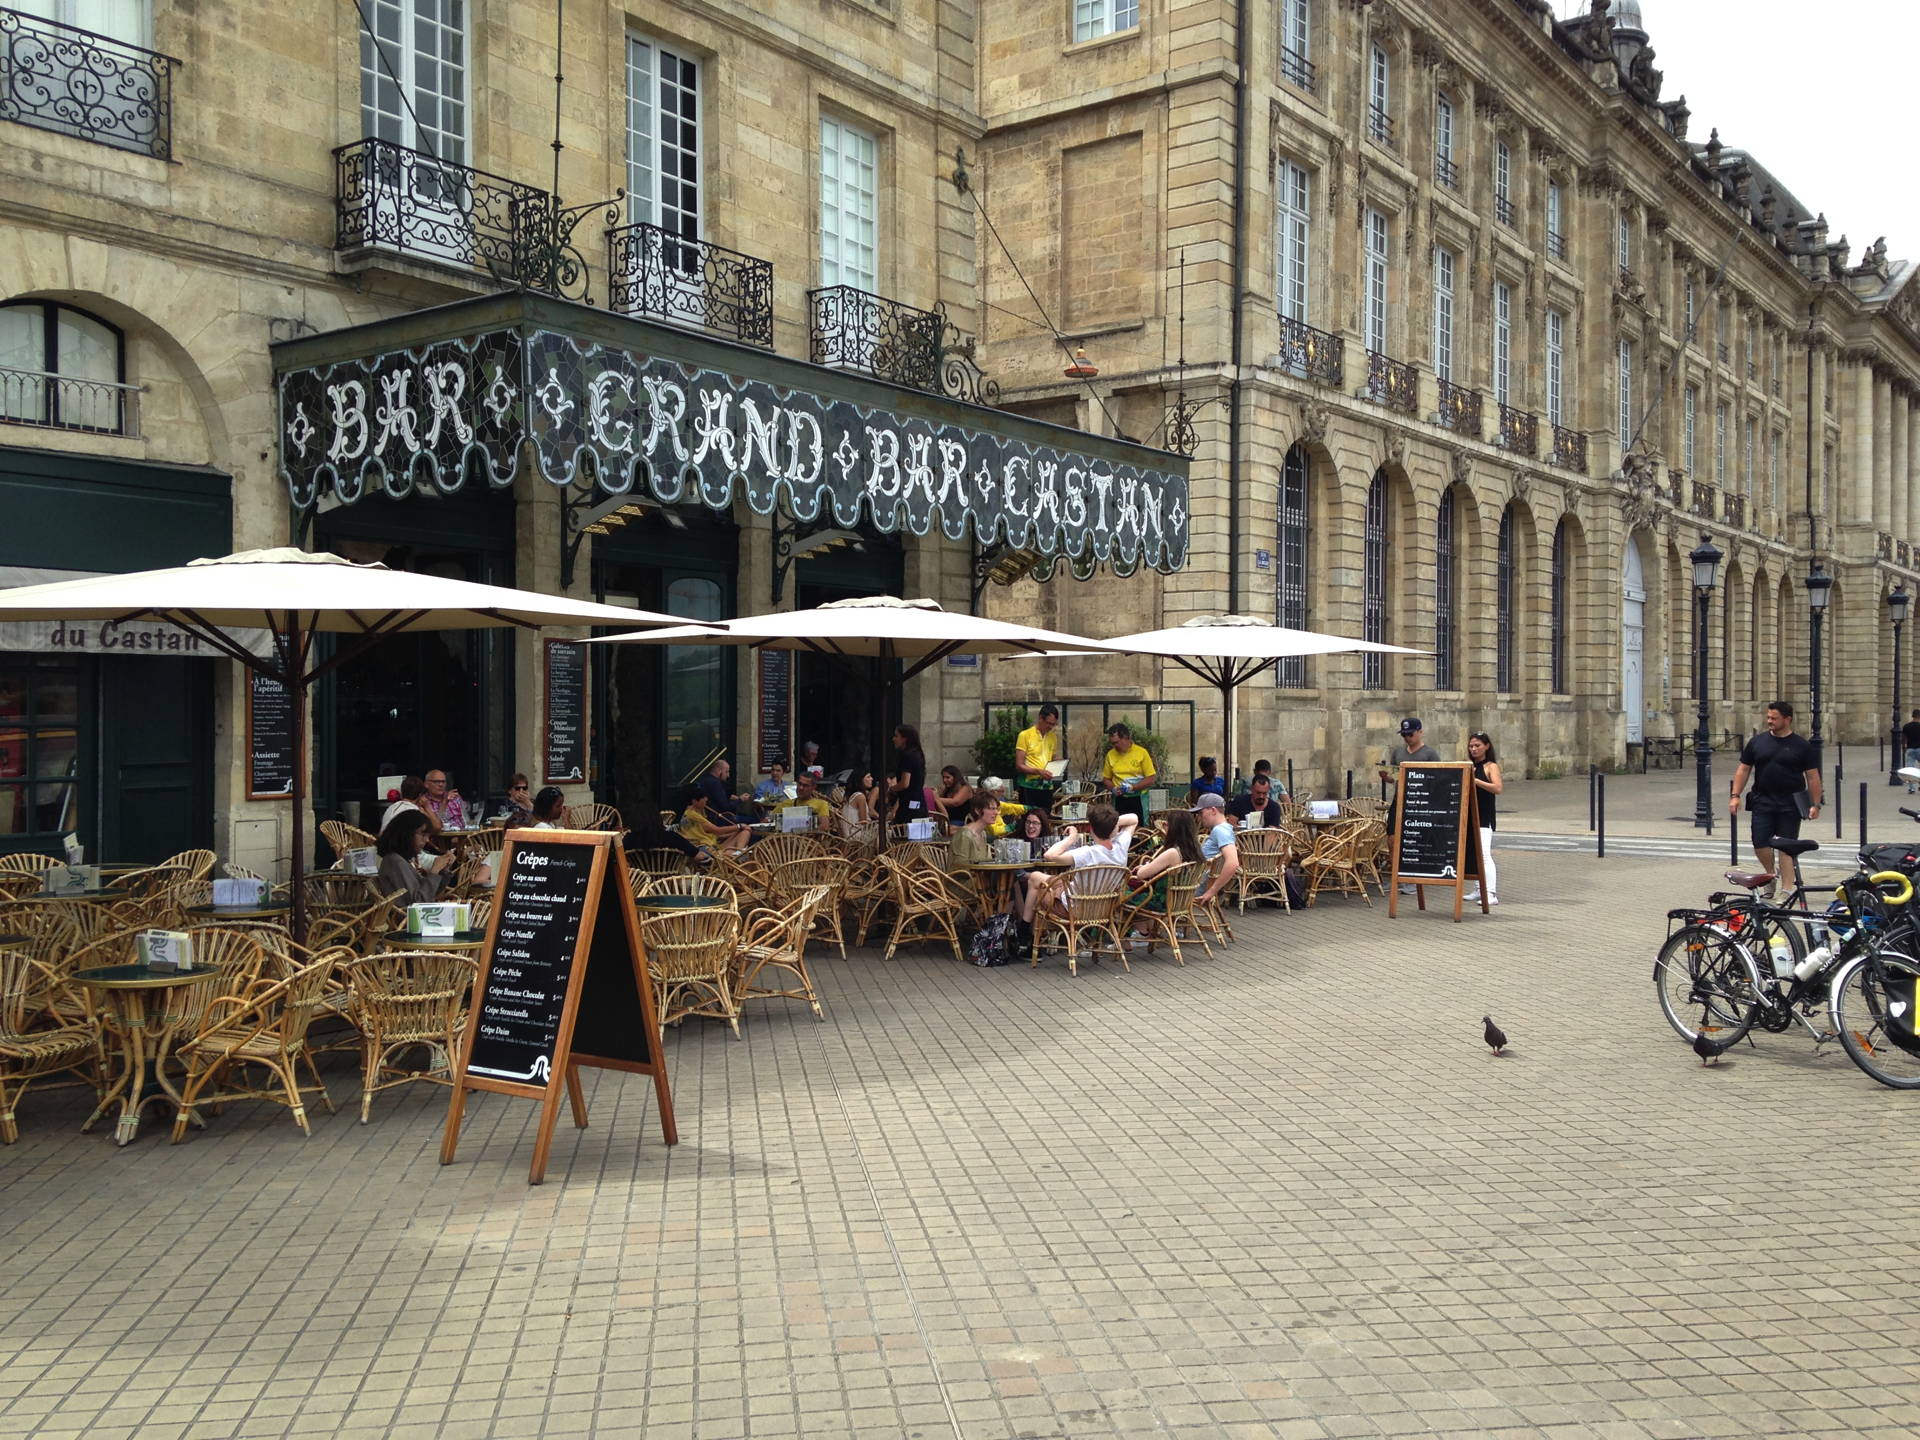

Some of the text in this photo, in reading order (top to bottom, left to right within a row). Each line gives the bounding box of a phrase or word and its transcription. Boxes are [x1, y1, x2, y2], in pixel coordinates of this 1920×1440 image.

[327, 361, 473, 464] BAR
[588, 369, 1164, 540] GRAND BAR CASTAN
[51, 620, 200, 650] du Castan
[1408, 771, 1425, 779] Plats
[1405, 819, 1432, 828] Galettes
[517, 851, 549, 869] Crêpes
